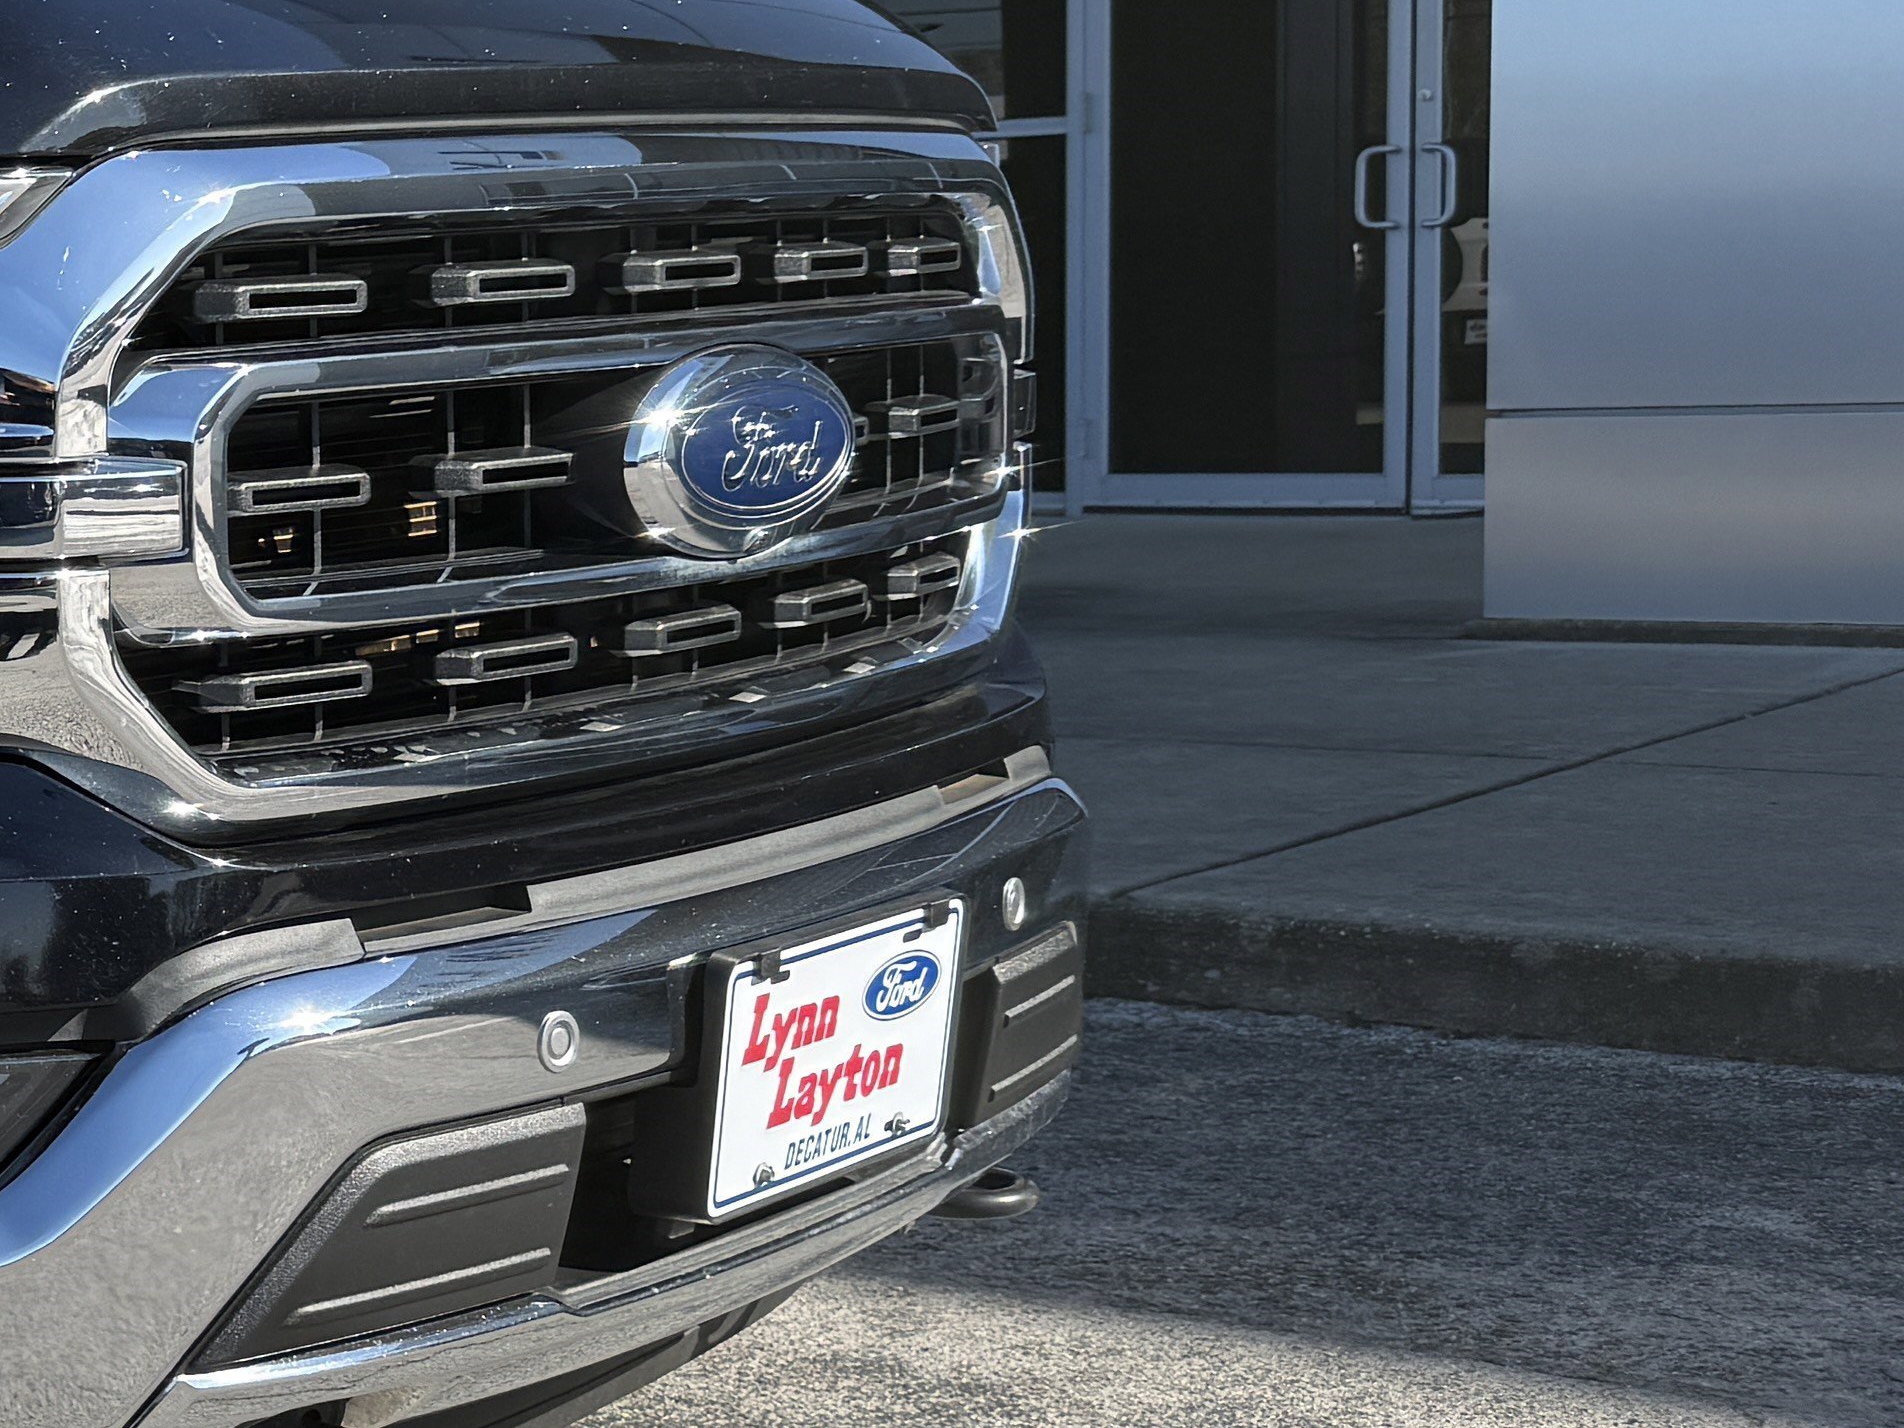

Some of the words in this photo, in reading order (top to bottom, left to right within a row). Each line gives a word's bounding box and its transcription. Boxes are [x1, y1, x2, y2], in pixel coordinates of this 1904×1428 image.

[721, 404, 823, 492] Ford
[875, 960, 928, 1013] Ford
[741, 992, 840, 1072] Lynn
[766, 1043, 904, 1130] Layton
[853, 1112, 872, 1144] AL
